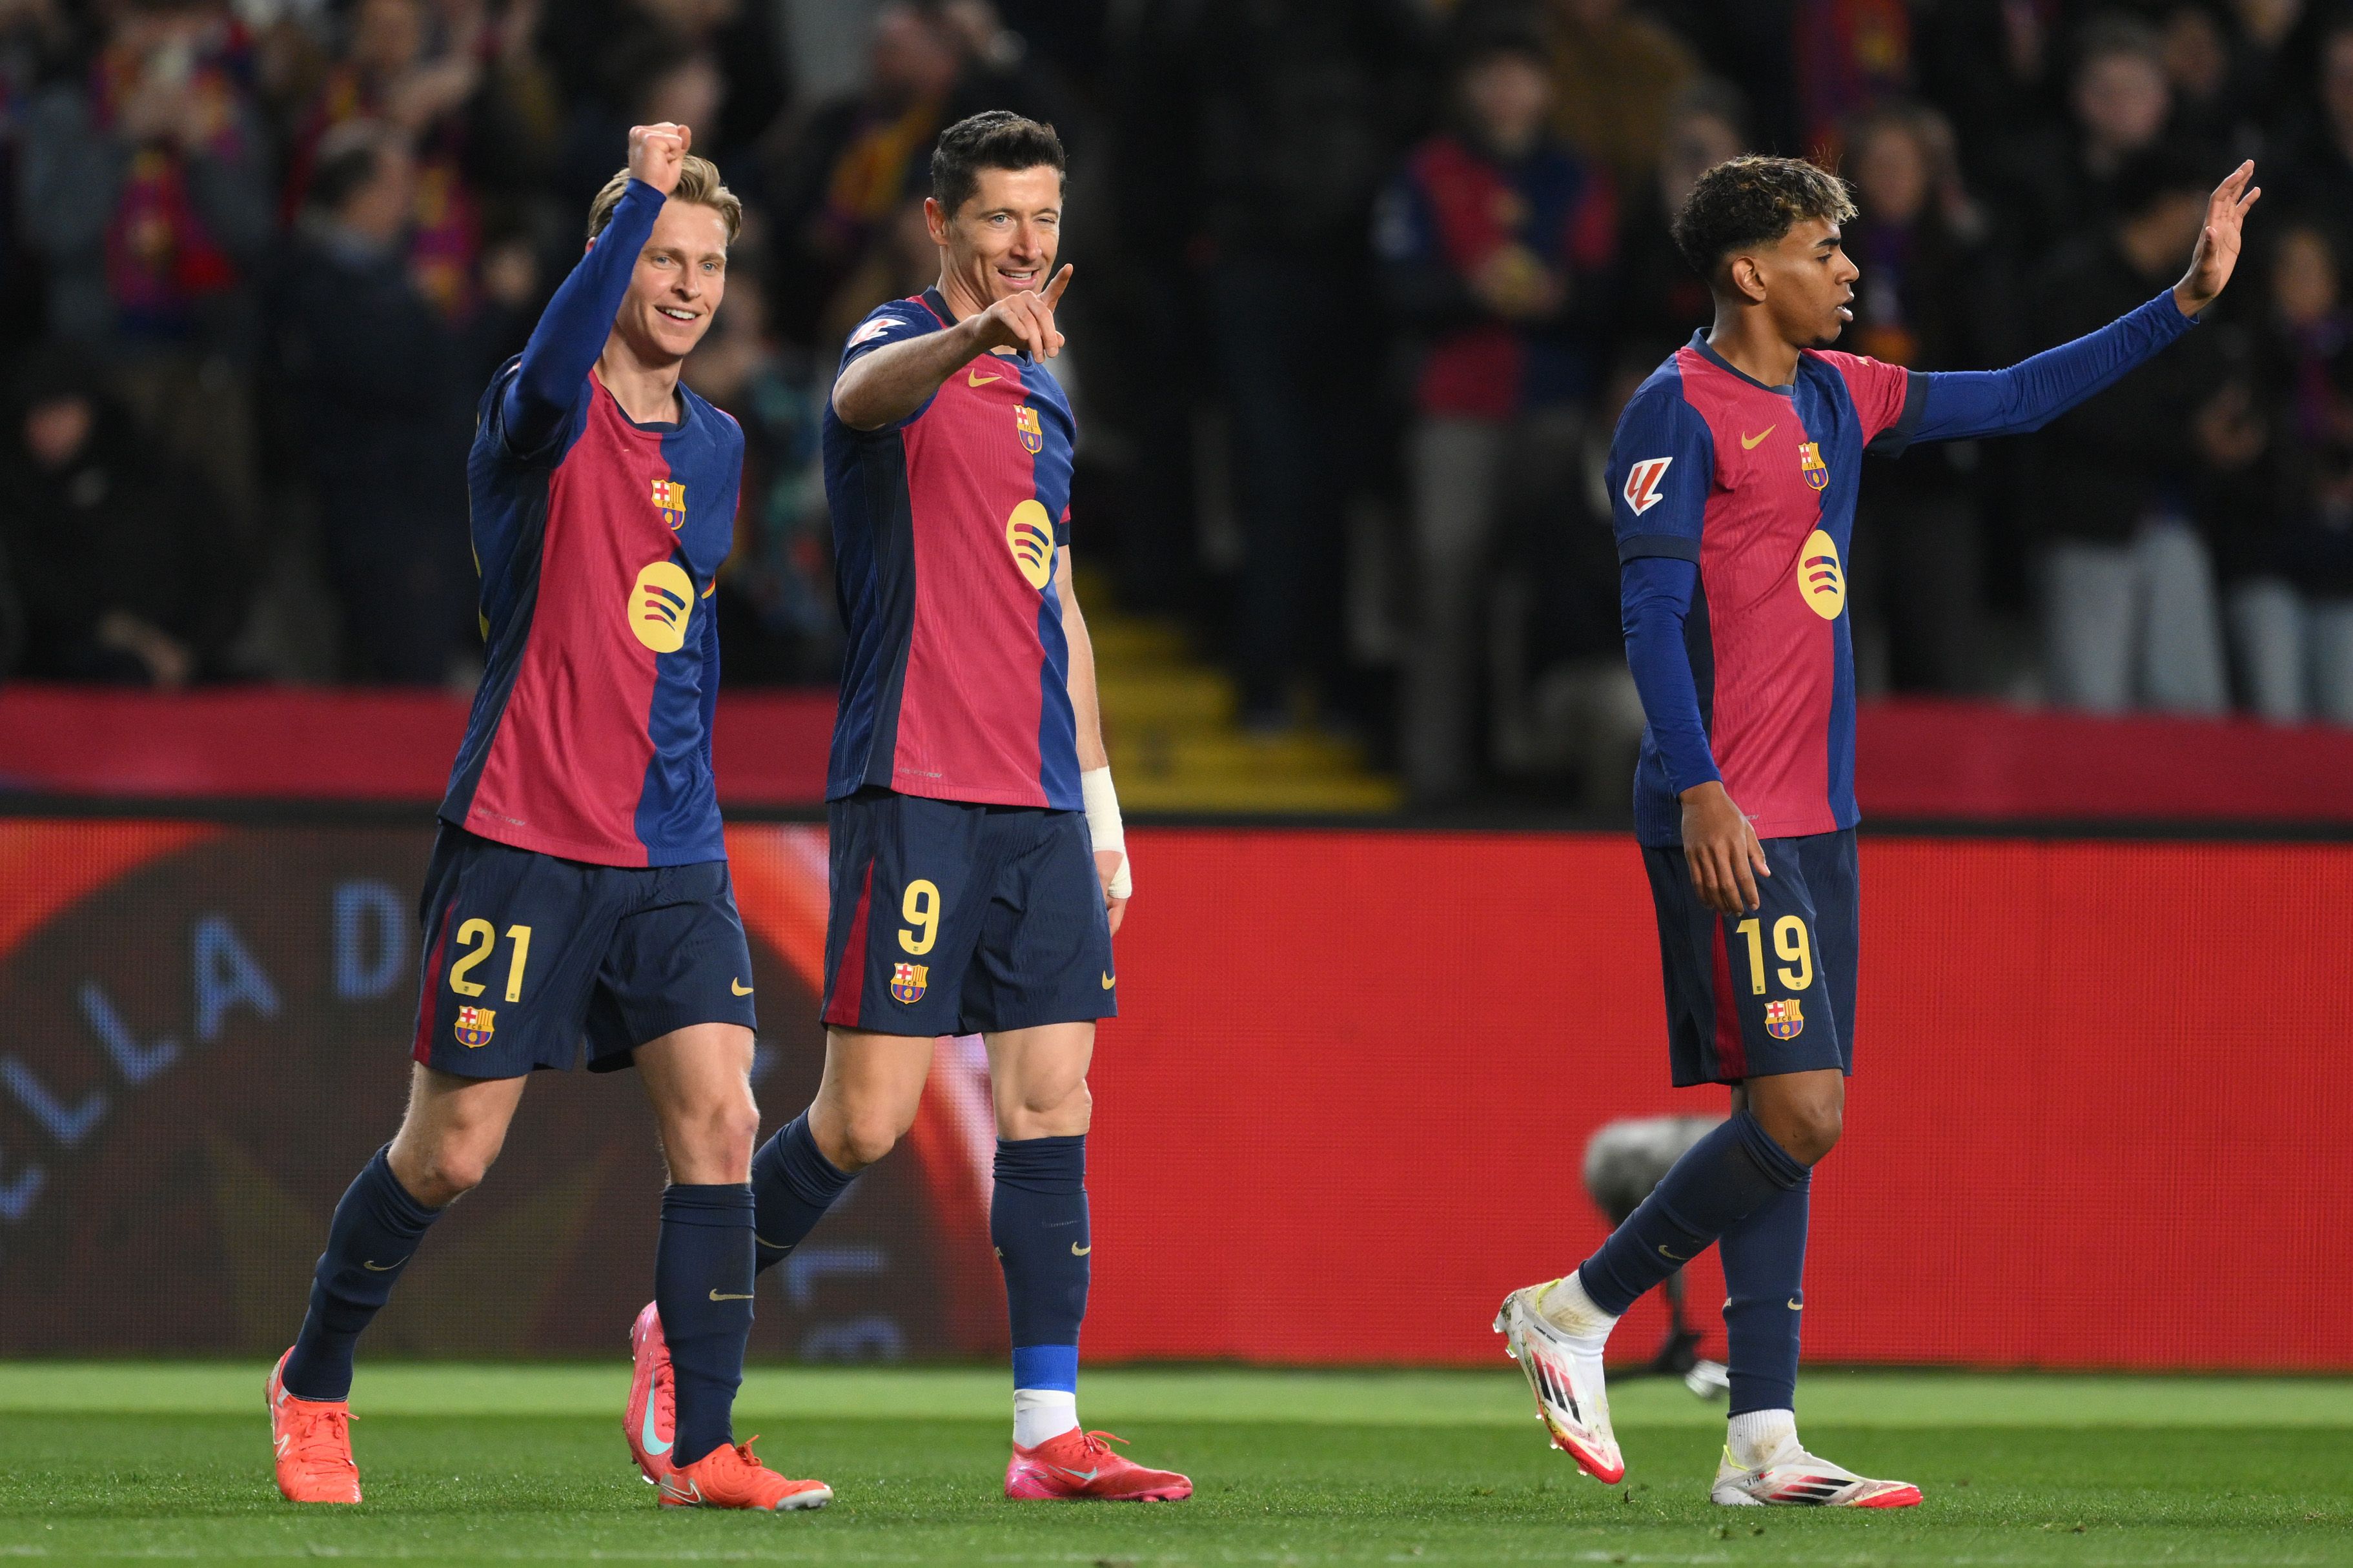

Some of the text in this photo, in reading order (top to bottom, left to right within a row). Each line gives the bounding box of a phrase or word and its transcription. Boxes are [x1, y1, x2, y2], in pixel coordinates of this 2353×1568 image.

[898, 879, 941, 955] 9
[1736, 915, 1813, 995] 19
[449, 918, 531, 1003] 21
